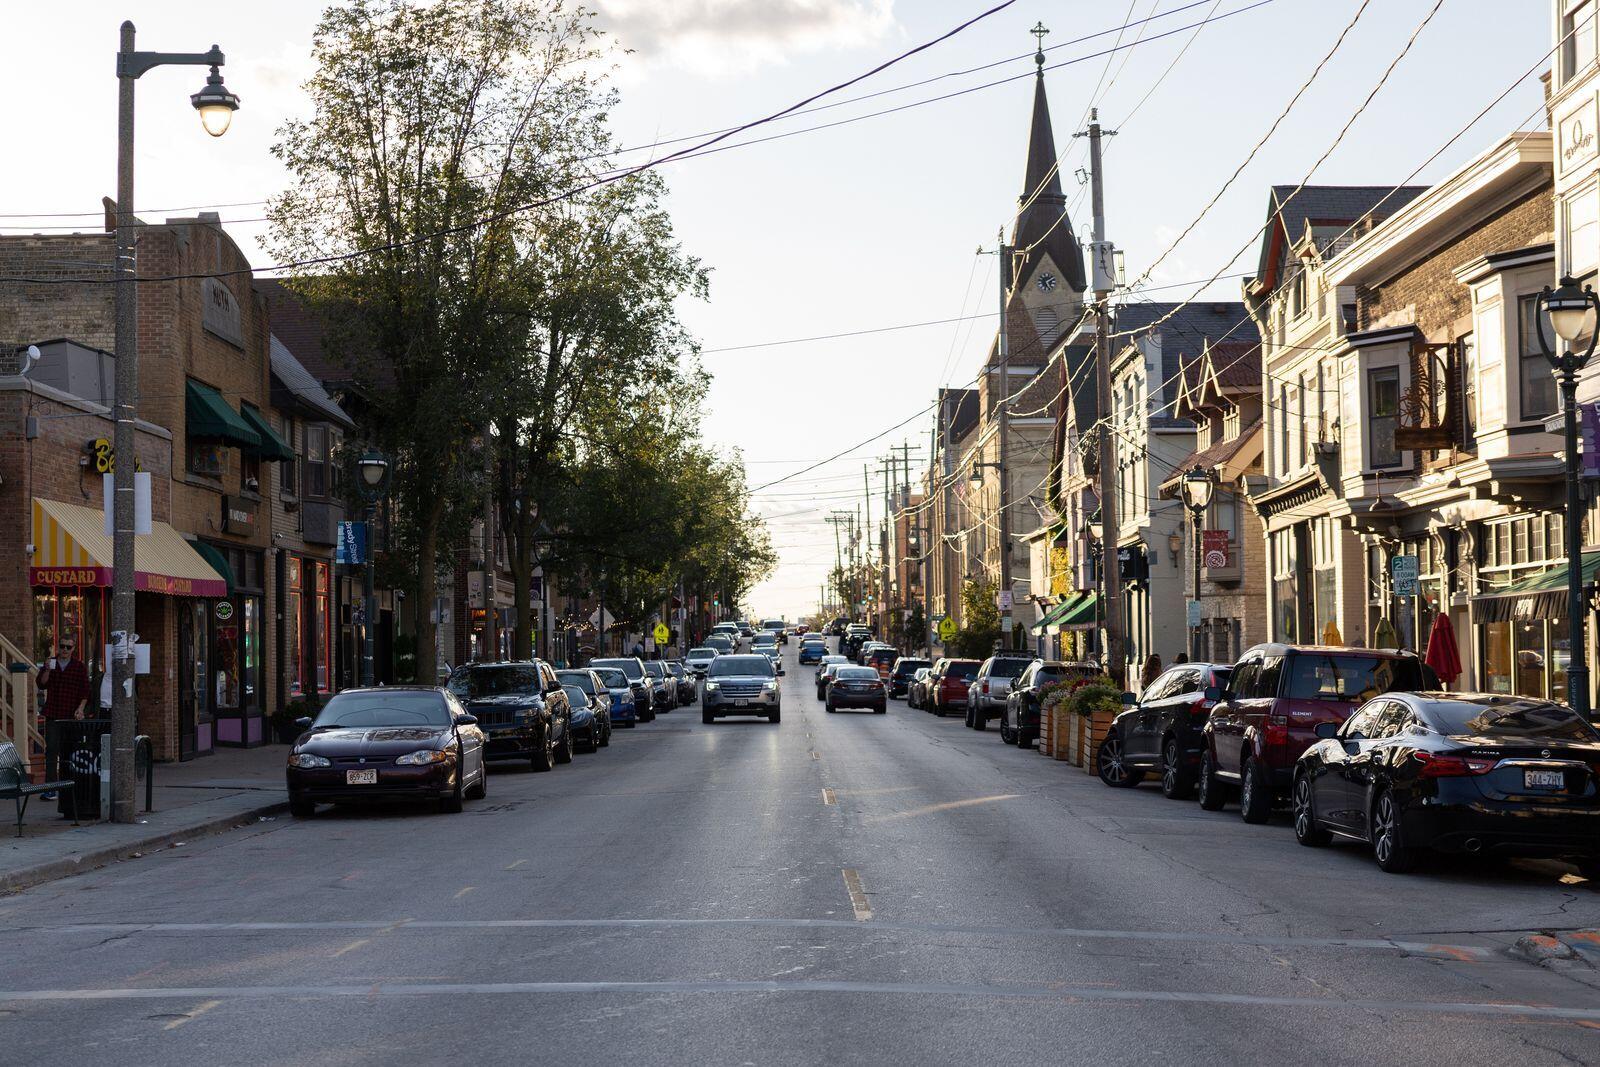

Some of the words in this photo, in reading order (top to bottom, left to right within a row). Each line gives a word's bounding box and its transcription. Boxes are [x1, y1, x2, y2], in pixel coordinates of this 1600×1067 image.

[345, 521, 355, 543] Brady
[350, 544, 359, 564] Street
[37, 570, 96, 584] CUSTARD
